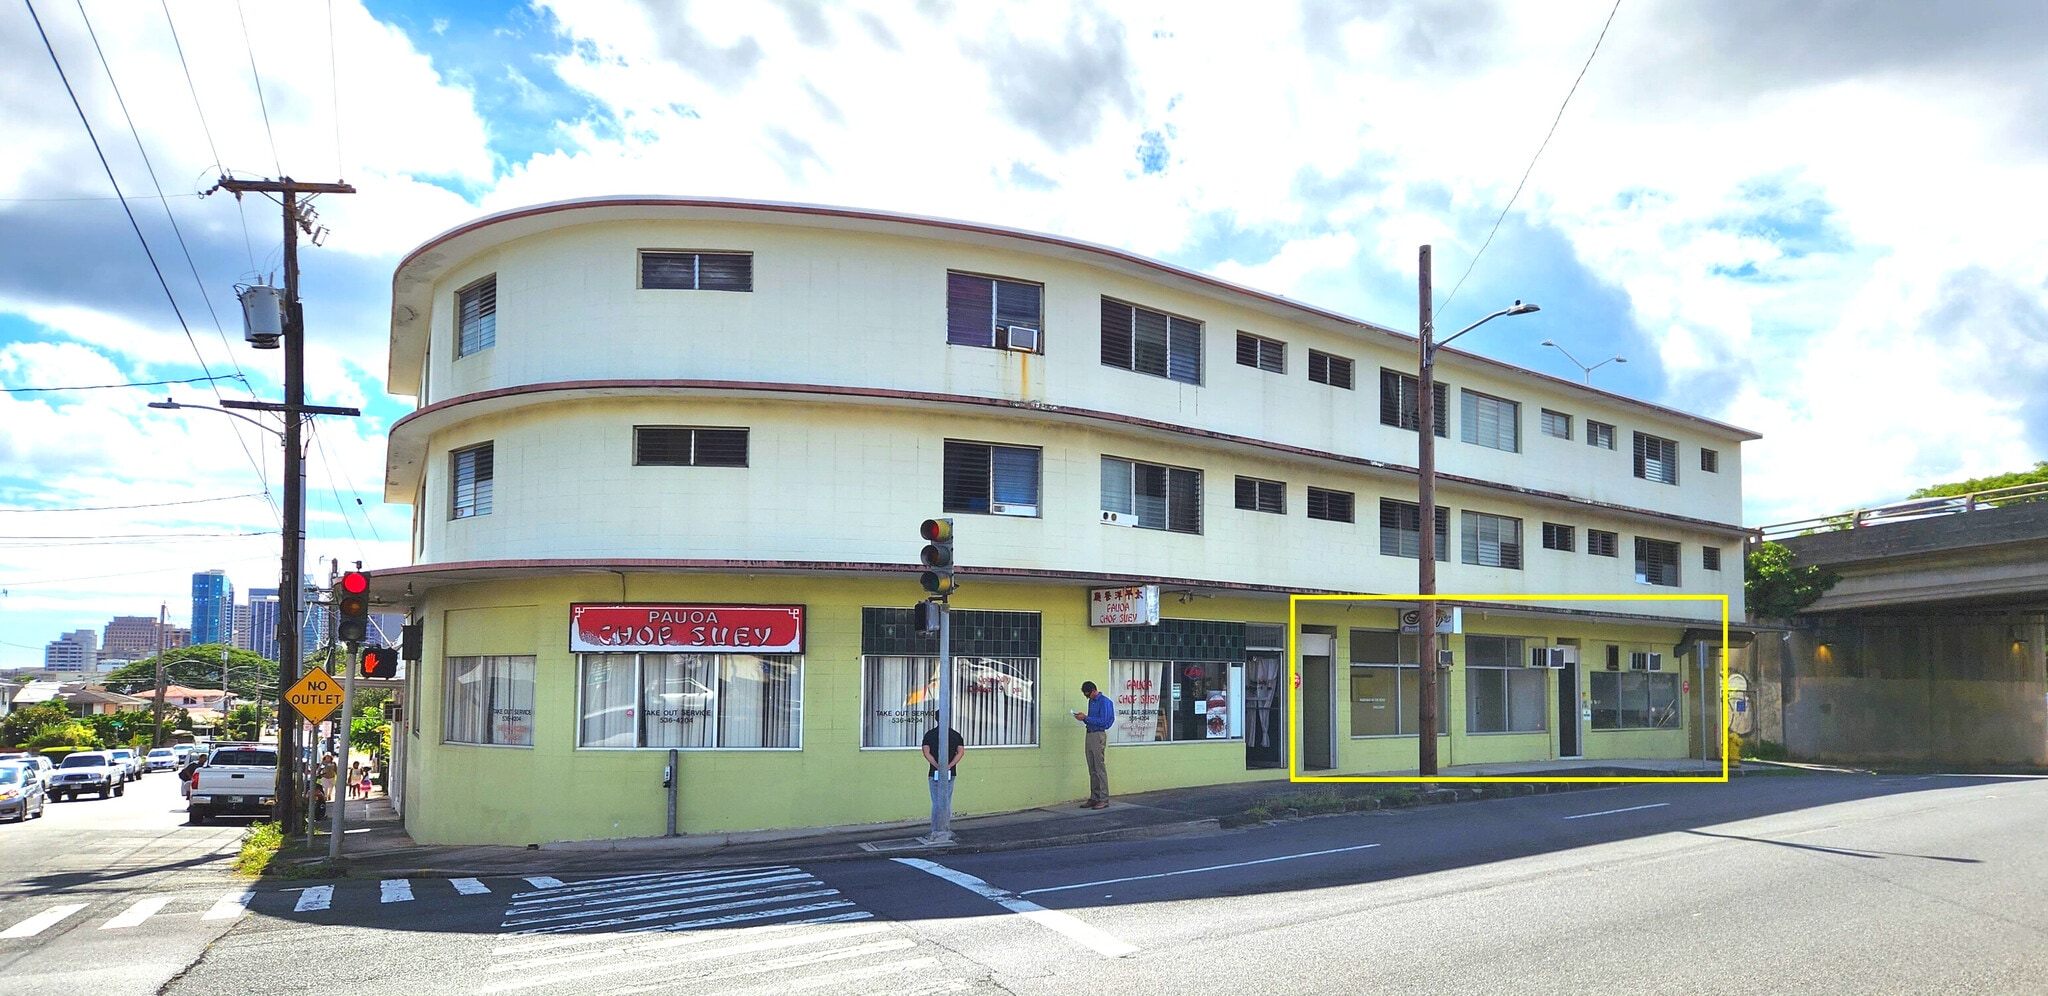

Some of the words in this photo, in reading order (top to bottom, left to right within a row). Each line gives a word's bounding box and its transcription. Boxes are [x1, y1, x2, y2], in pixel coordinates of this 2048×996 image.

[1107, 603, 1130, 612] PAUOA
[649, 611, 718, 624] PAUOA
[1100, 614, 1116, 623] CHOP
[1120, 613, 1138, 622] SUEY
[599, 626, 672, 646] CHOP
[690, 626, 772, 646] SUEY
[307, 681, 328, 691] NO
[1126, 680, 1152, 690] PAUOA
[291, 694, 342, 705] OUTLET
[1118, 694, 1137, 704] CHOP
[1140, 694, 1160, 704] SUEY
